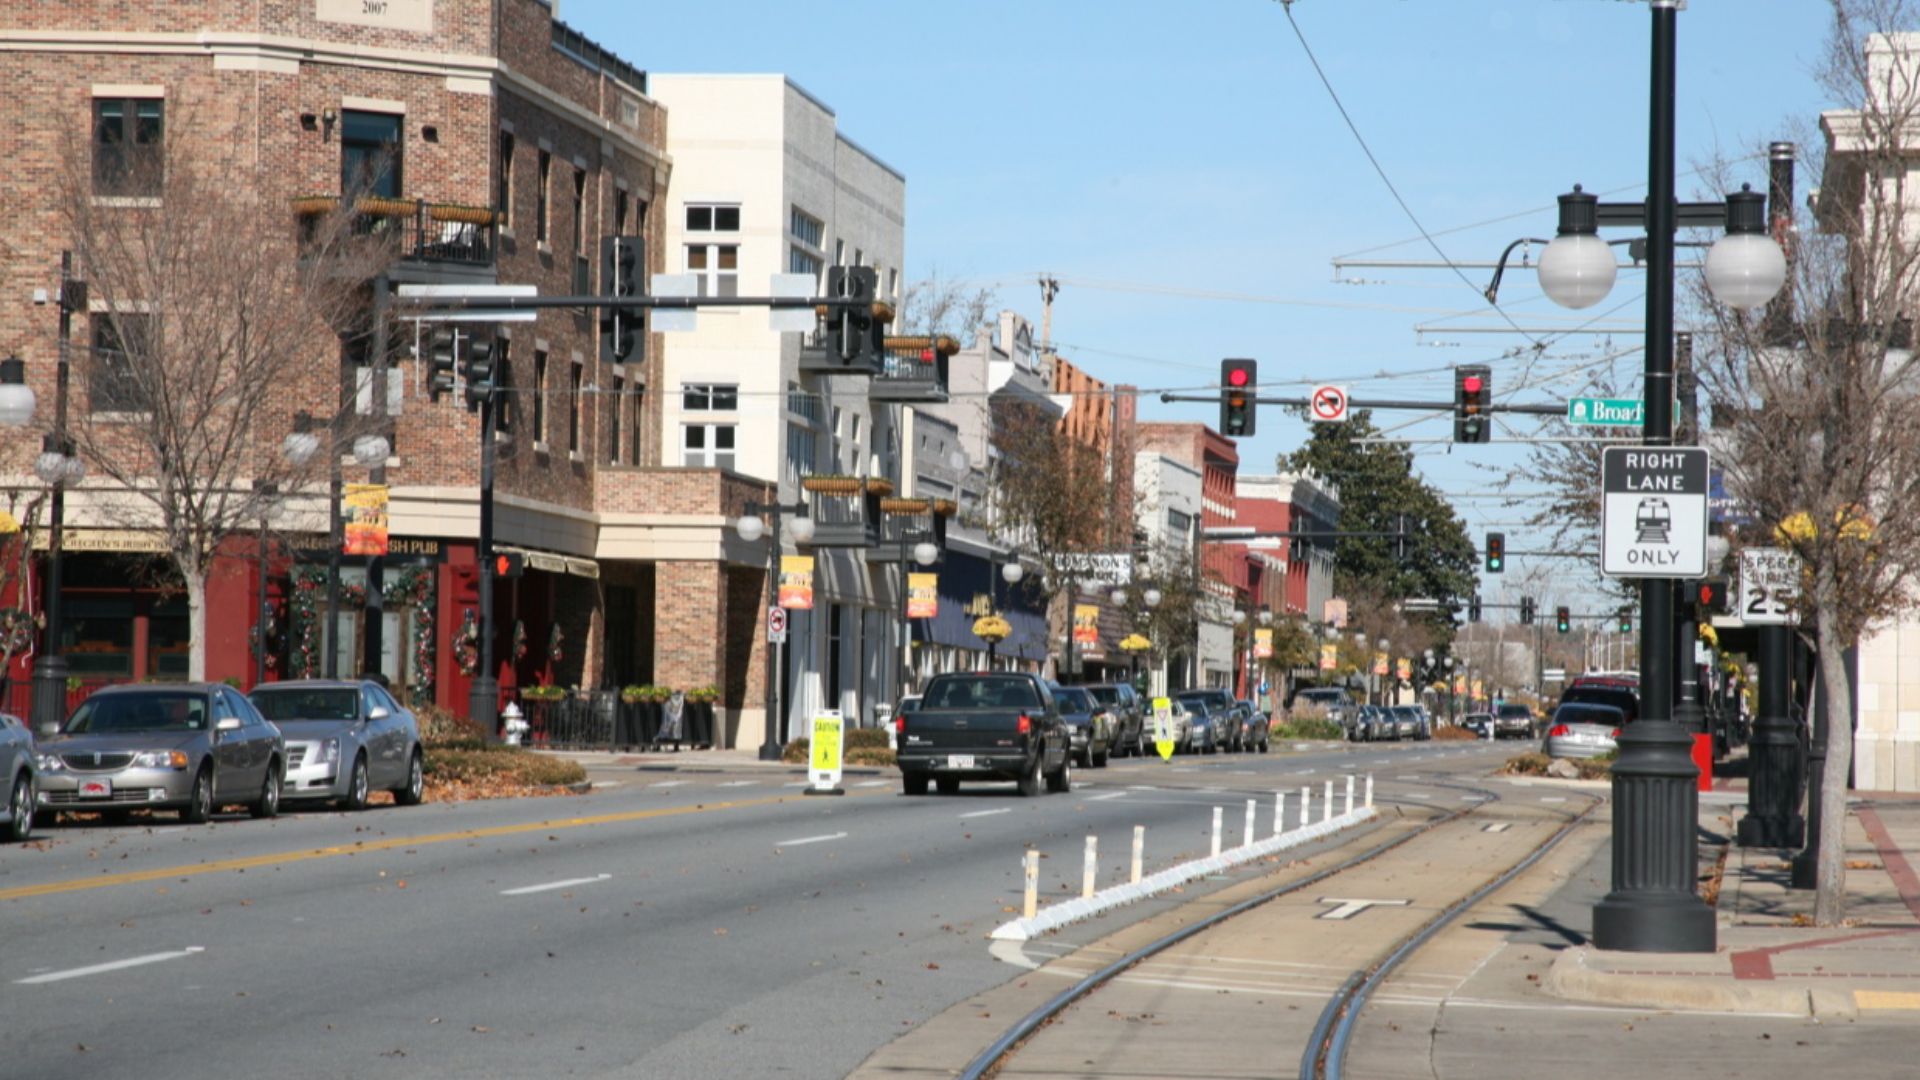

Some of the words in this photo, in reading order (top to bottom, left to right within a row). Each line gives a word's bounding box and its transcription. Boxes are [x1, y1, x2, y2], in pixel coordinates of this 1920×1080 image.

[362, 0, 388, 15] 2007
[1592, 401, 1644, 421] Broad
[1626, 453, 1685, 468] RIGHT
[1627, 475, 1684, 490] LANE
[411, 541, 438, 554] PUB
[1627, 550, 1680, 565] ONLY
[1747, 587, 1793, 614] 25
